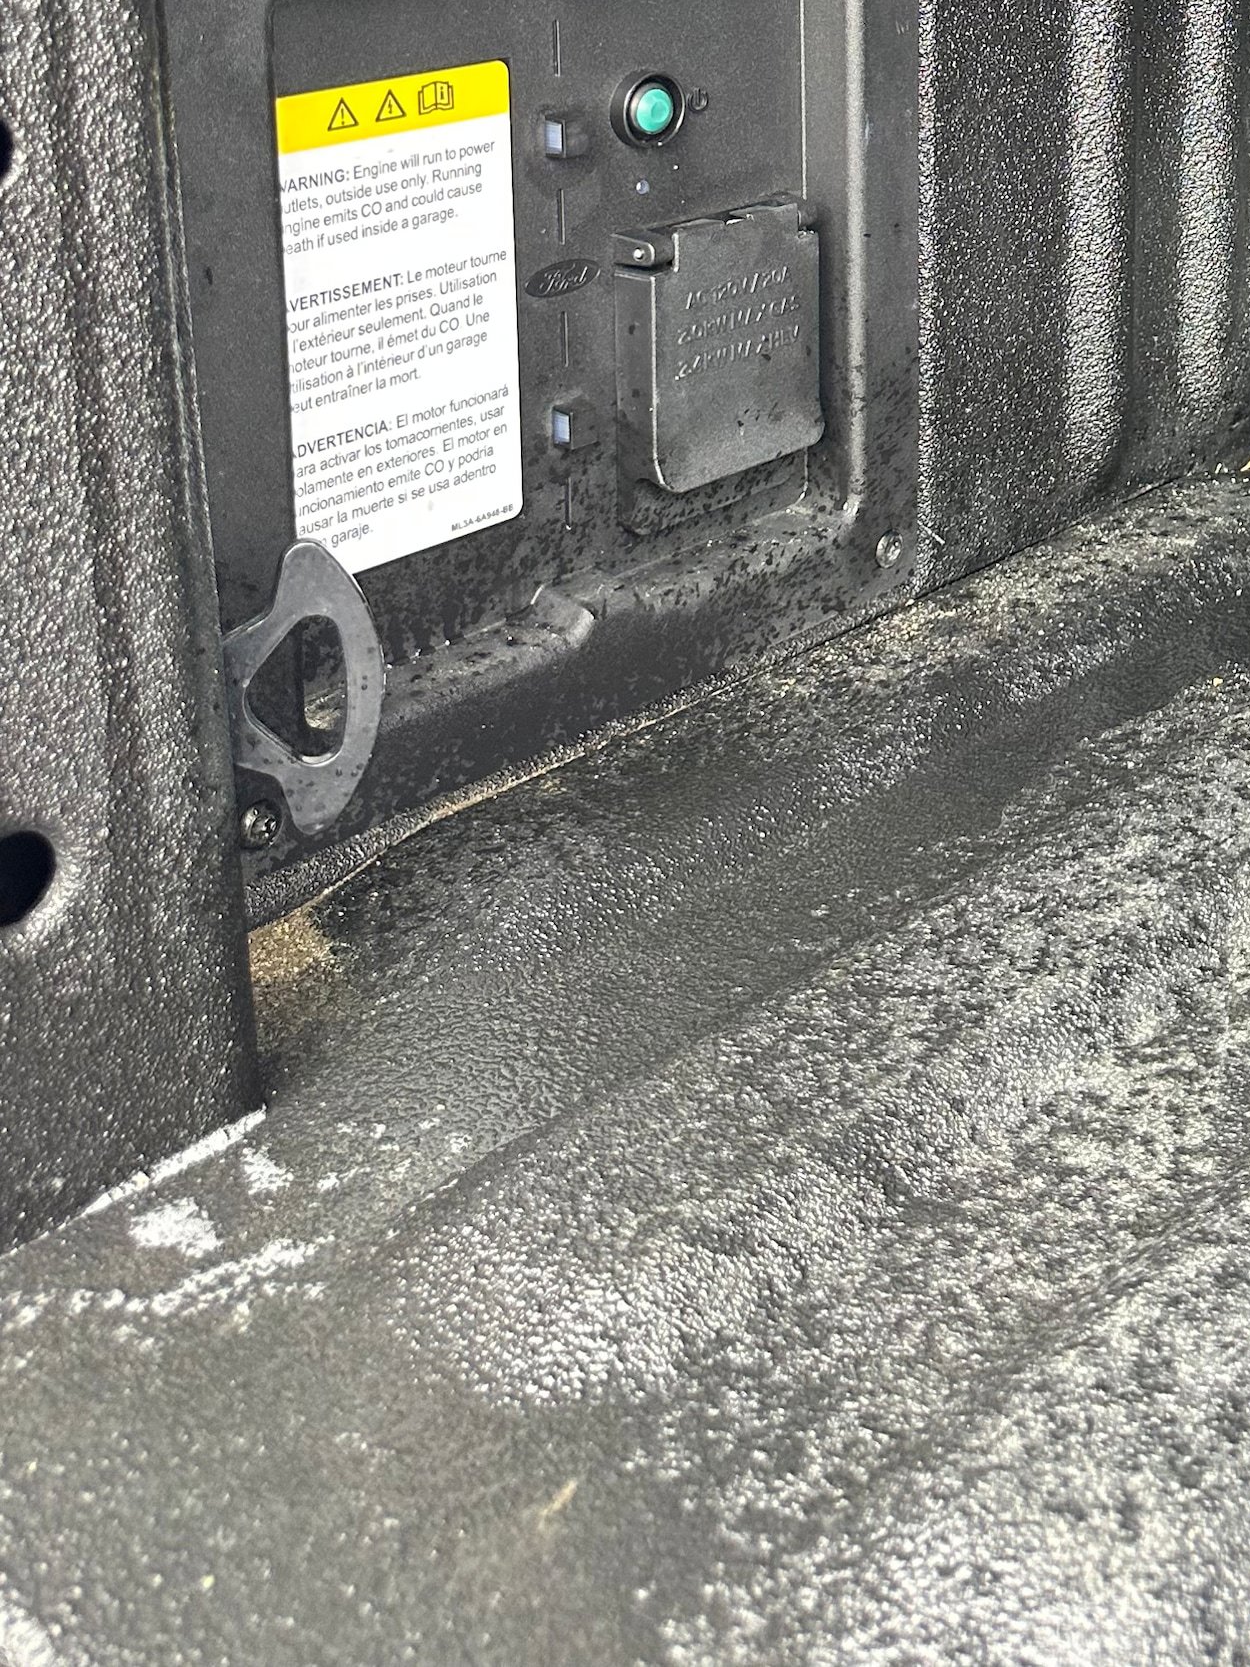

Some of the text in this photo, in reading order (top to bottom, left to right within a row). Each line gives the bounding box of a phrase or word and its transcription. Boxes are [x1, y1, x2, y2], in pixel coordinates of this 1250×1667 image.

[353, 161, 397, 179] Engine
[400, 153, 419, 169] will
[422, 152, 441, 164] run
[445, 149, 456, 160] to
[459, 141, 494, 160] power
[325, 184, 371, 205] outside
[375, 181, 397, 195] use
[400, 173, 429, 189] only.
[432, 163, 481, 182] Running
[282, 182, 482, 236] ngine emits CO and could cause
[283, 208, 462, 254] eath if used inside a garage.
[286, 250, 506, 313] VERTISSEMENT: Le moteur tourne
[312, 302, 371, 327] alimenter
[374, 297, 392, 311] les
[395, 288, 437, 309] prises.
[439, 271, 496, 294] Utilisation
[330, 343, 374, 362] tourne,
[378, 336, 383, 350] il
[420, 325, 436, 338] du
[465, 311, 489, 326] Une
[358, 307, 426, 335] seulement.
[429, 295, 469, 316] Quand
[472, 293, 482, 305] le
[346, 365, 353, 378] à
[446, 331, 487, 354] garage
[290, 367, 421, 413] eut entraîner la mort.
[319, 449, 360, 470] activar
[364, 443, 382, 456] los
[480, 405, 504, 422] usar
[396, 413, 408, 428] El
[412, 405, 446, 423] motor
[294, 471, 353, 497] olamente
[357, 465, 372, 478] en
[442, 437, 453, 452] El
[457, 428, 490, 447] motor
[493, 423, 507, 435] en
[387, 469, 420, 488] emite
[424, 459, 444, 476] CO
[447, 459, 454, 472] y
[298, 463, 496, 535] ausar la muerte si se usa adentro
[331, 524, 373, 548] garaje.
